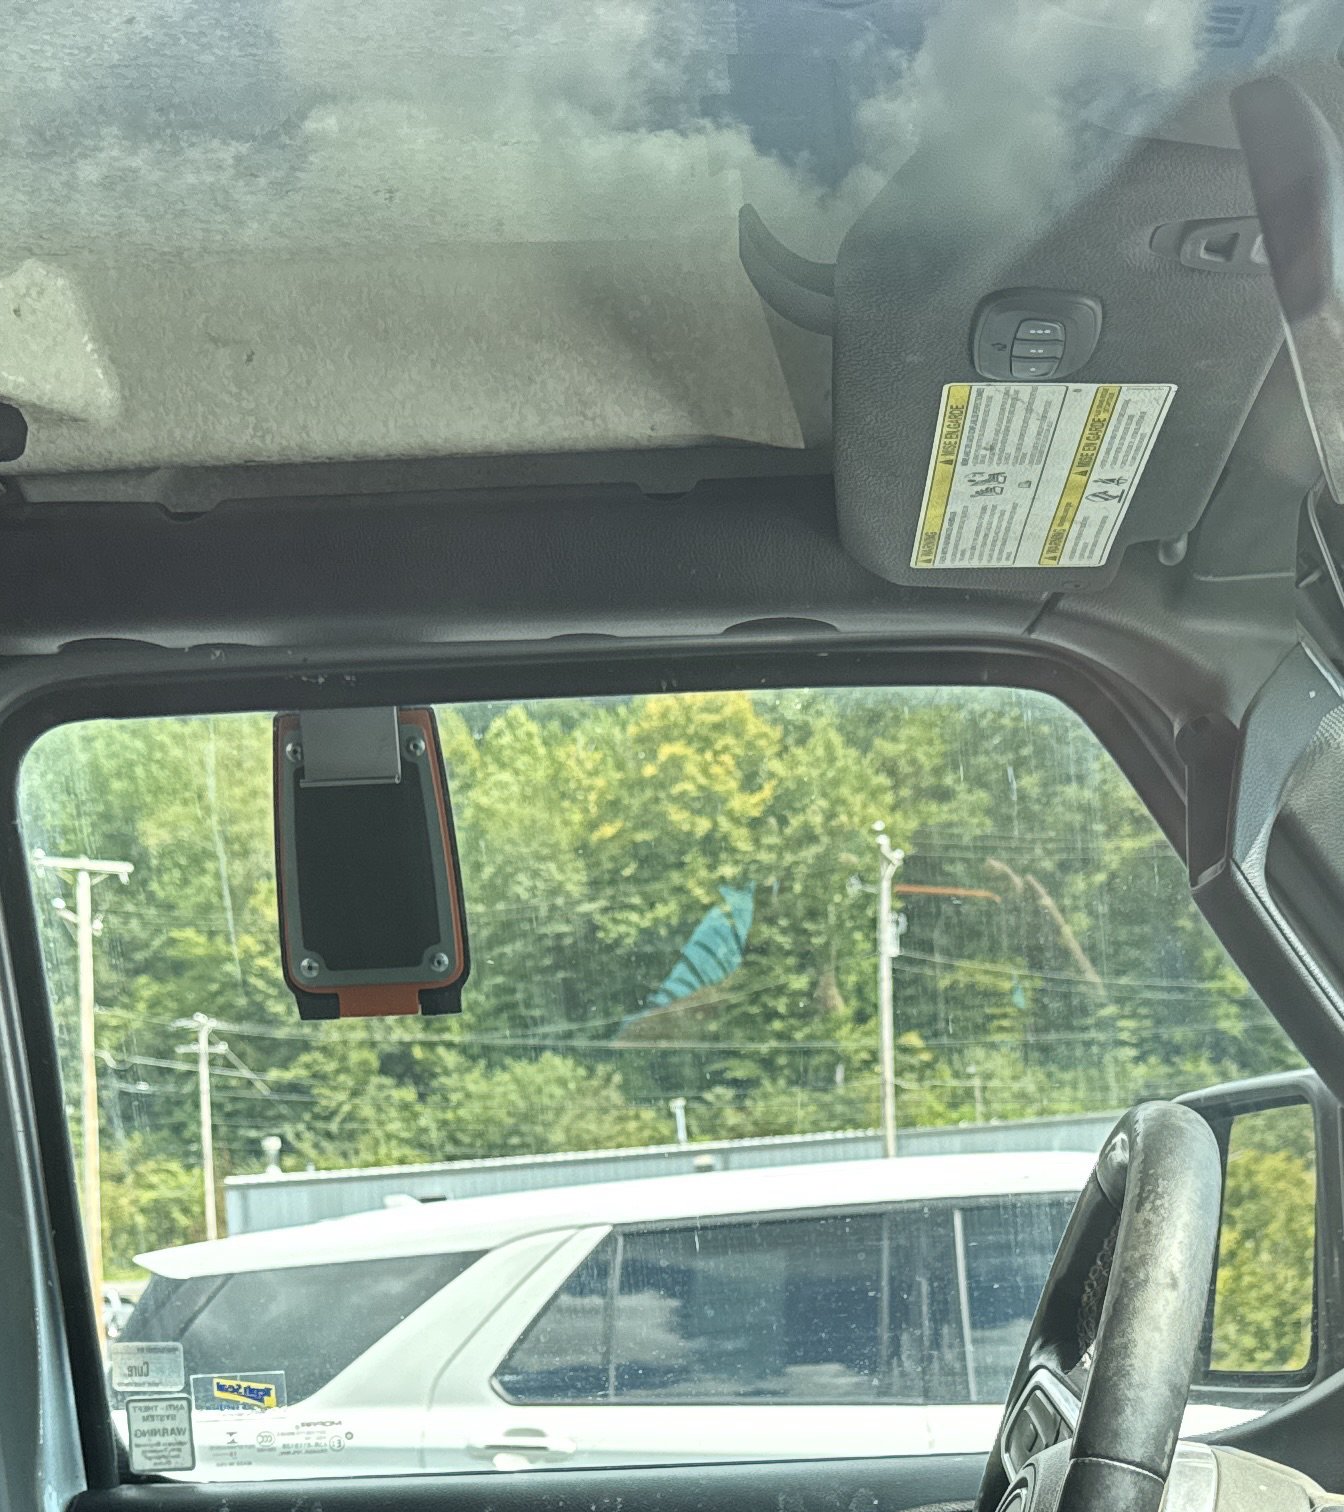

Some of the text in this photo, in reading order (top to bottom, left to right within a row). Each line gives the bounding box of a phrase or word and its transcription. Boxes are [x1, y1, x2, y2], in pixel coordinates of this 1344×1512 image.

[941, 404, 965, 457] MISE EN GARDE
[1086, 416, 1107, 442] GARDE
[1075, 452, 1094, 468] MISE
[1080, 442, 1097, 452] EN
[920, 531, 938, 558] WARNING
